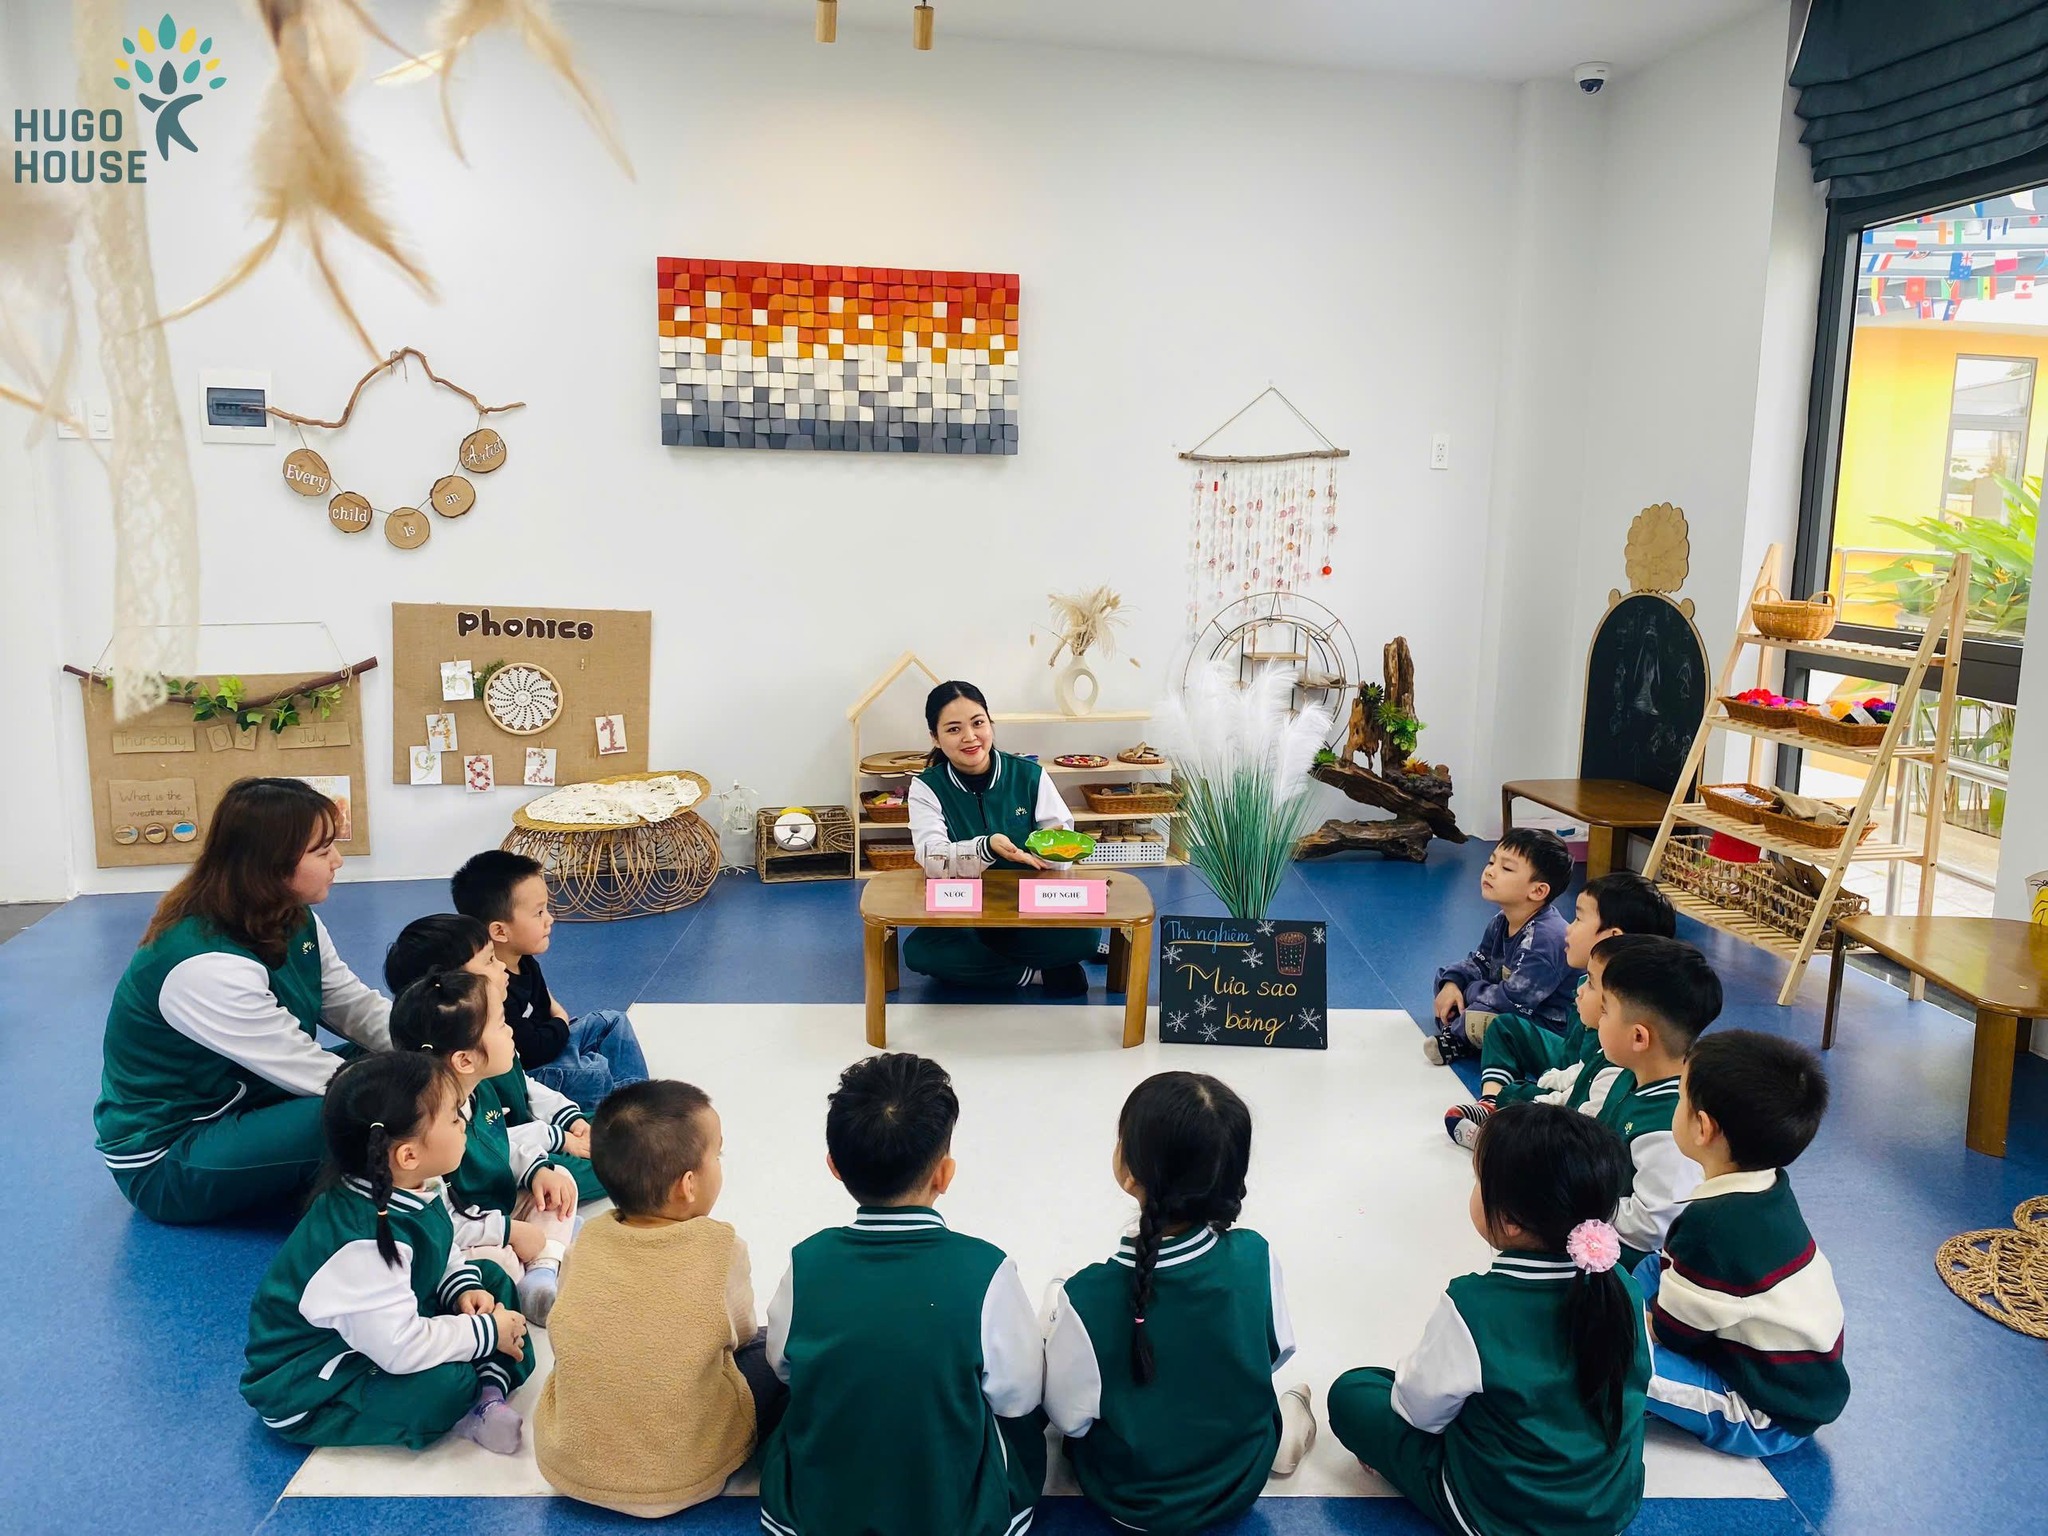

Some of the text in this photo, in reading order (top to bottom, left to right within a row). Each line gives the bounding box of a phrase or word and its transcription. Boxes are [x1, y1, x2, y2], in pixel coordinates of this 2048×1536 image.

[286, 464, 327, 492] Every
[332, 507, 367, 522] child
[444, 492, 461, 505] an
[464, 437, 504, 468] Artist
[119, 730, 187, 748] Thursday
[297, 727, 327, 746] July
[600, 719, 626, 752] 1
[467, 757, 490, 791] 8
[527, 751, 554, 784] 2
[120, 789, 182, 802] What is the
[129, 807, 163, 817] weather
[1257, 981, 1297, 996] sao
